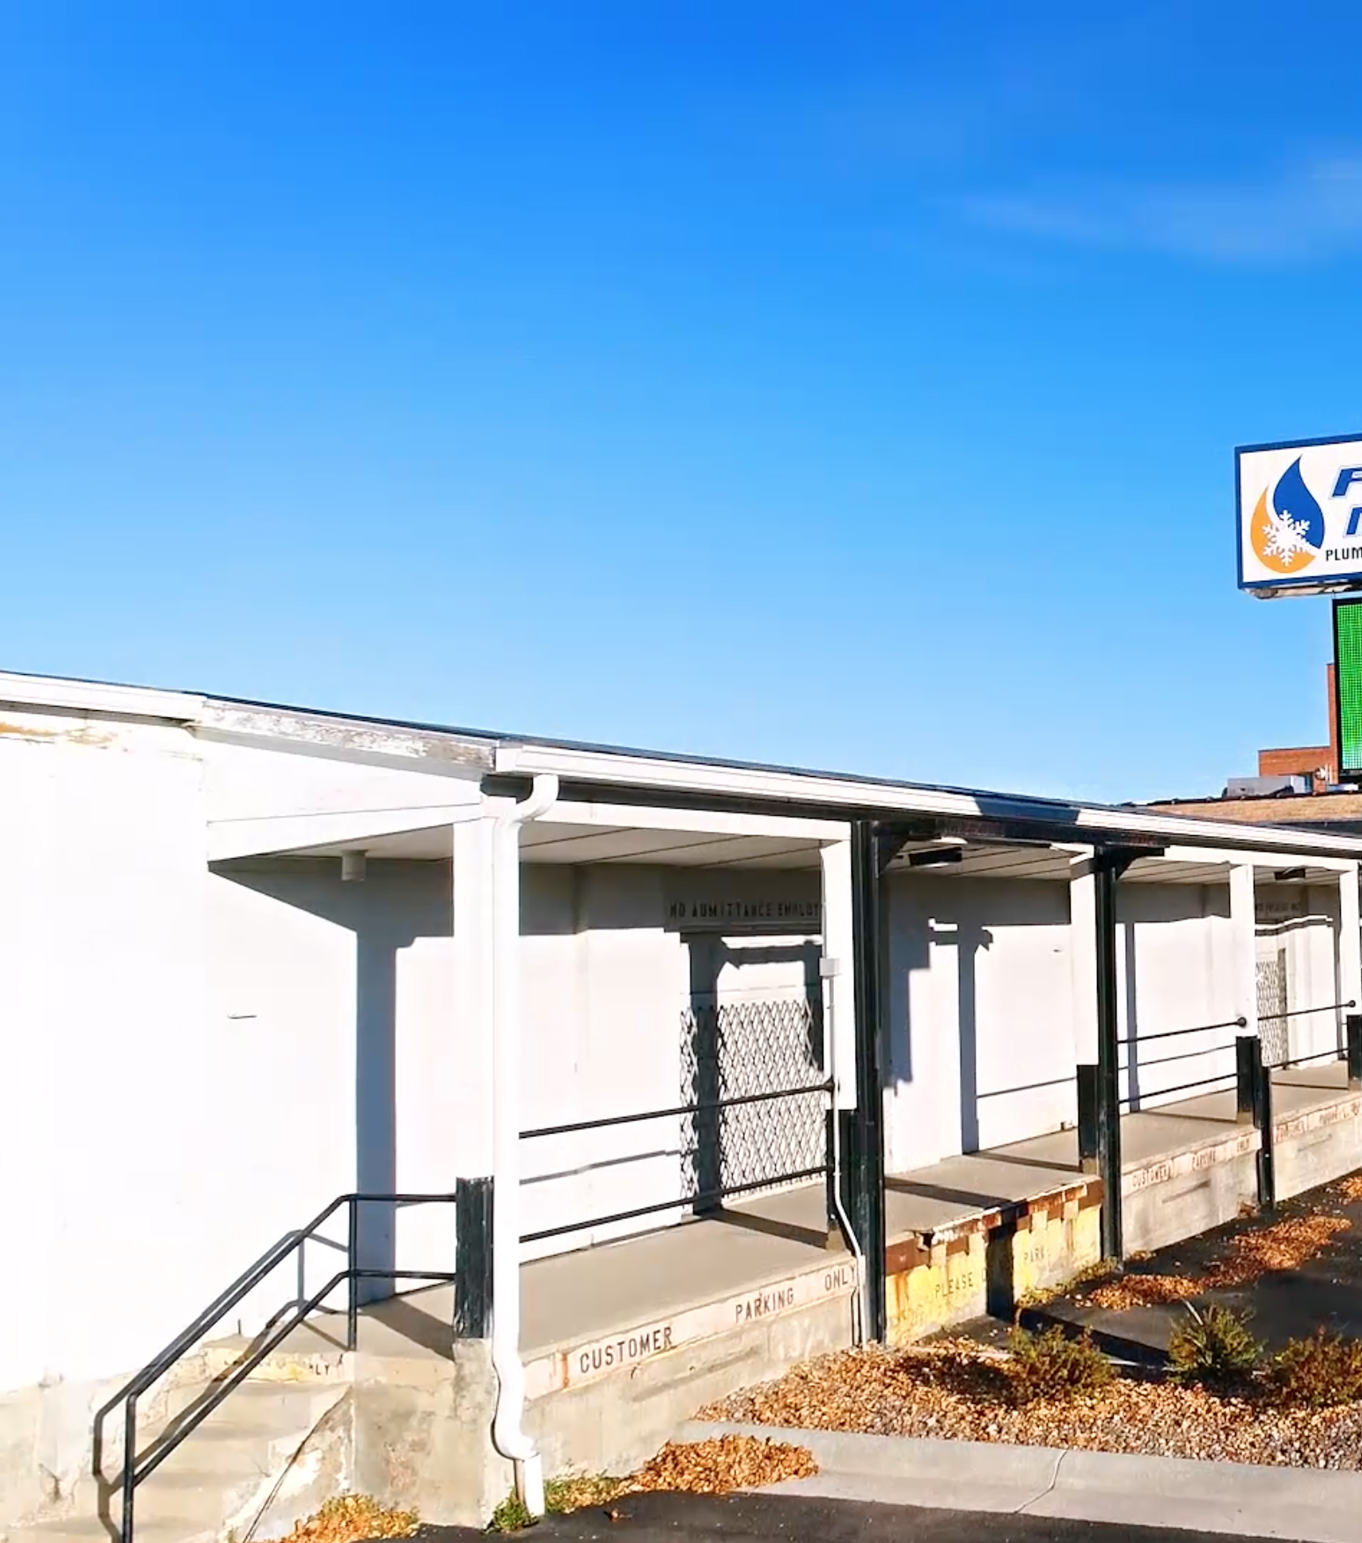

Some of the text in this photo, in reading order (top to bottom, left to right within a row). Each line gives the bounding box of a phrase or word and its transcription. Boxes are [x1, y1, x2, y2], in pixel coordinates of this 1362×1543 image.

[935, 1272, 974, 1299] PLEASE
[580, 1326, 673, 1374] CUSTOMER
[735, 1287, 795, 1323] PARKING
